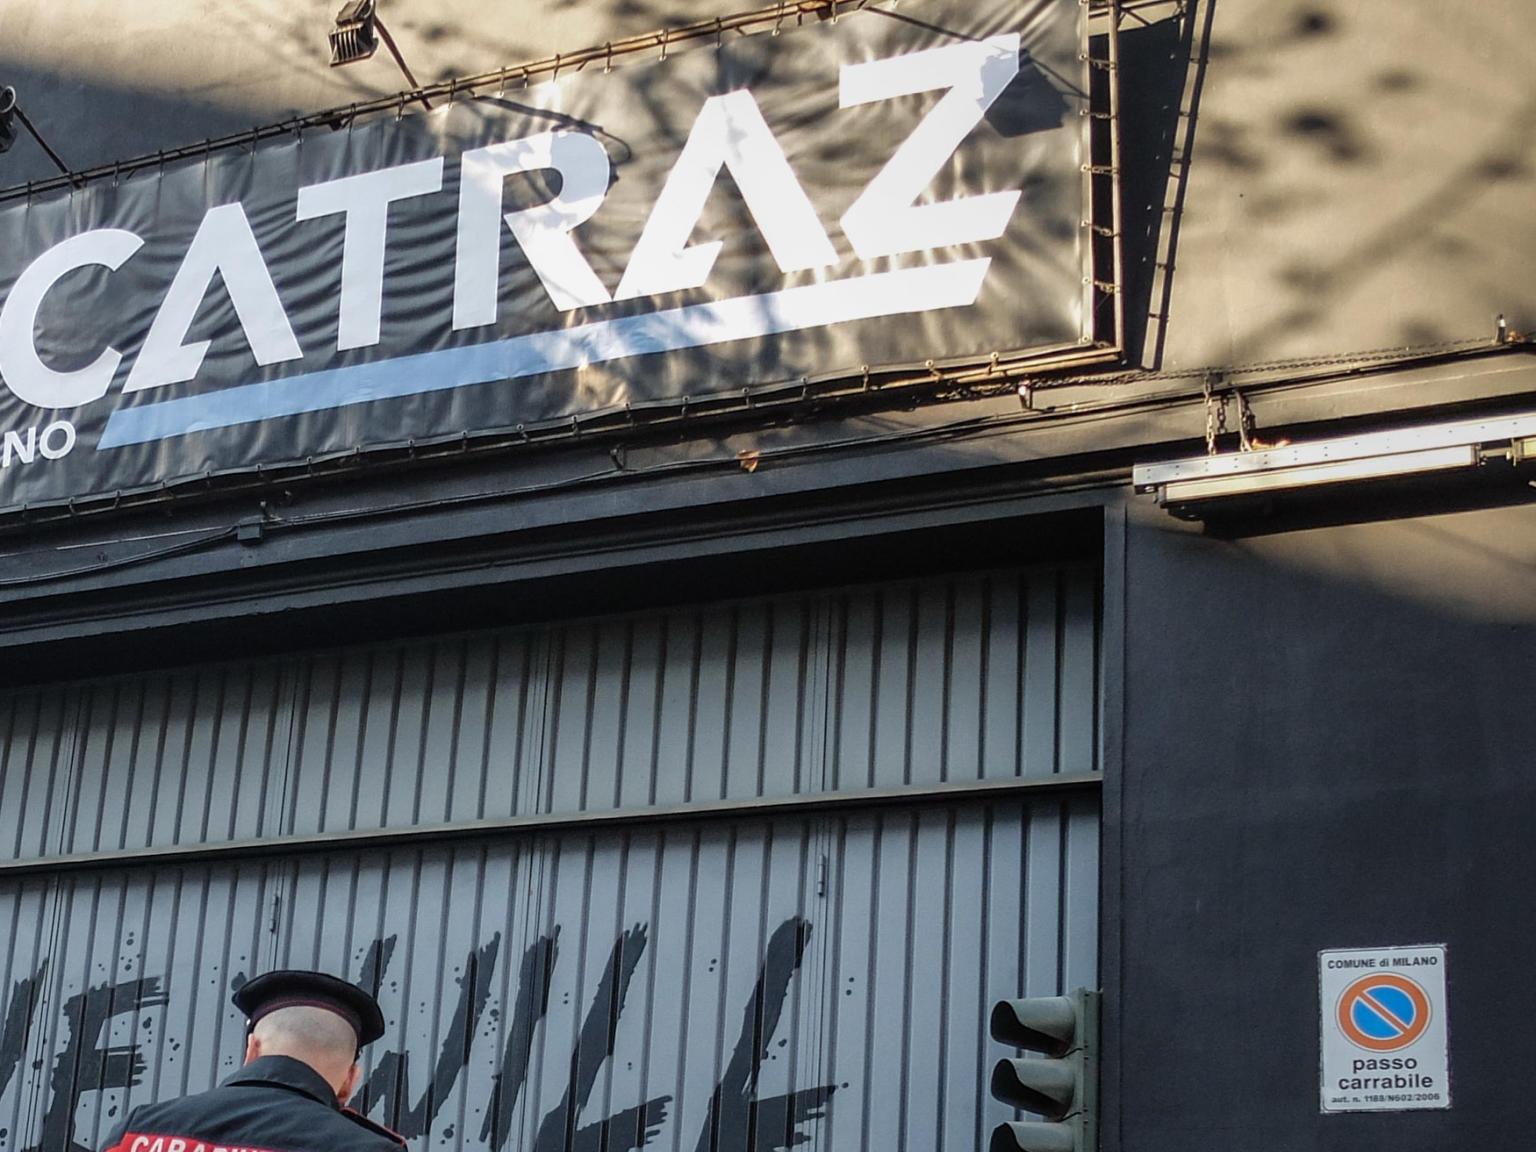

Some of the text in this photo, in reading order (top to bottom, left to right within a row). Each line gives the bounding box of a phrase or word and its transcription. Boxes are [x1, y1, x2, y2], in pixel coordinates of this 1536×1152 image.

[1327, 956, 1438, 969] COMUNE di MILANO
[1352, 1057, 1418, 1074] passo
[1338, 1073, 1433, 1090] carrabile
